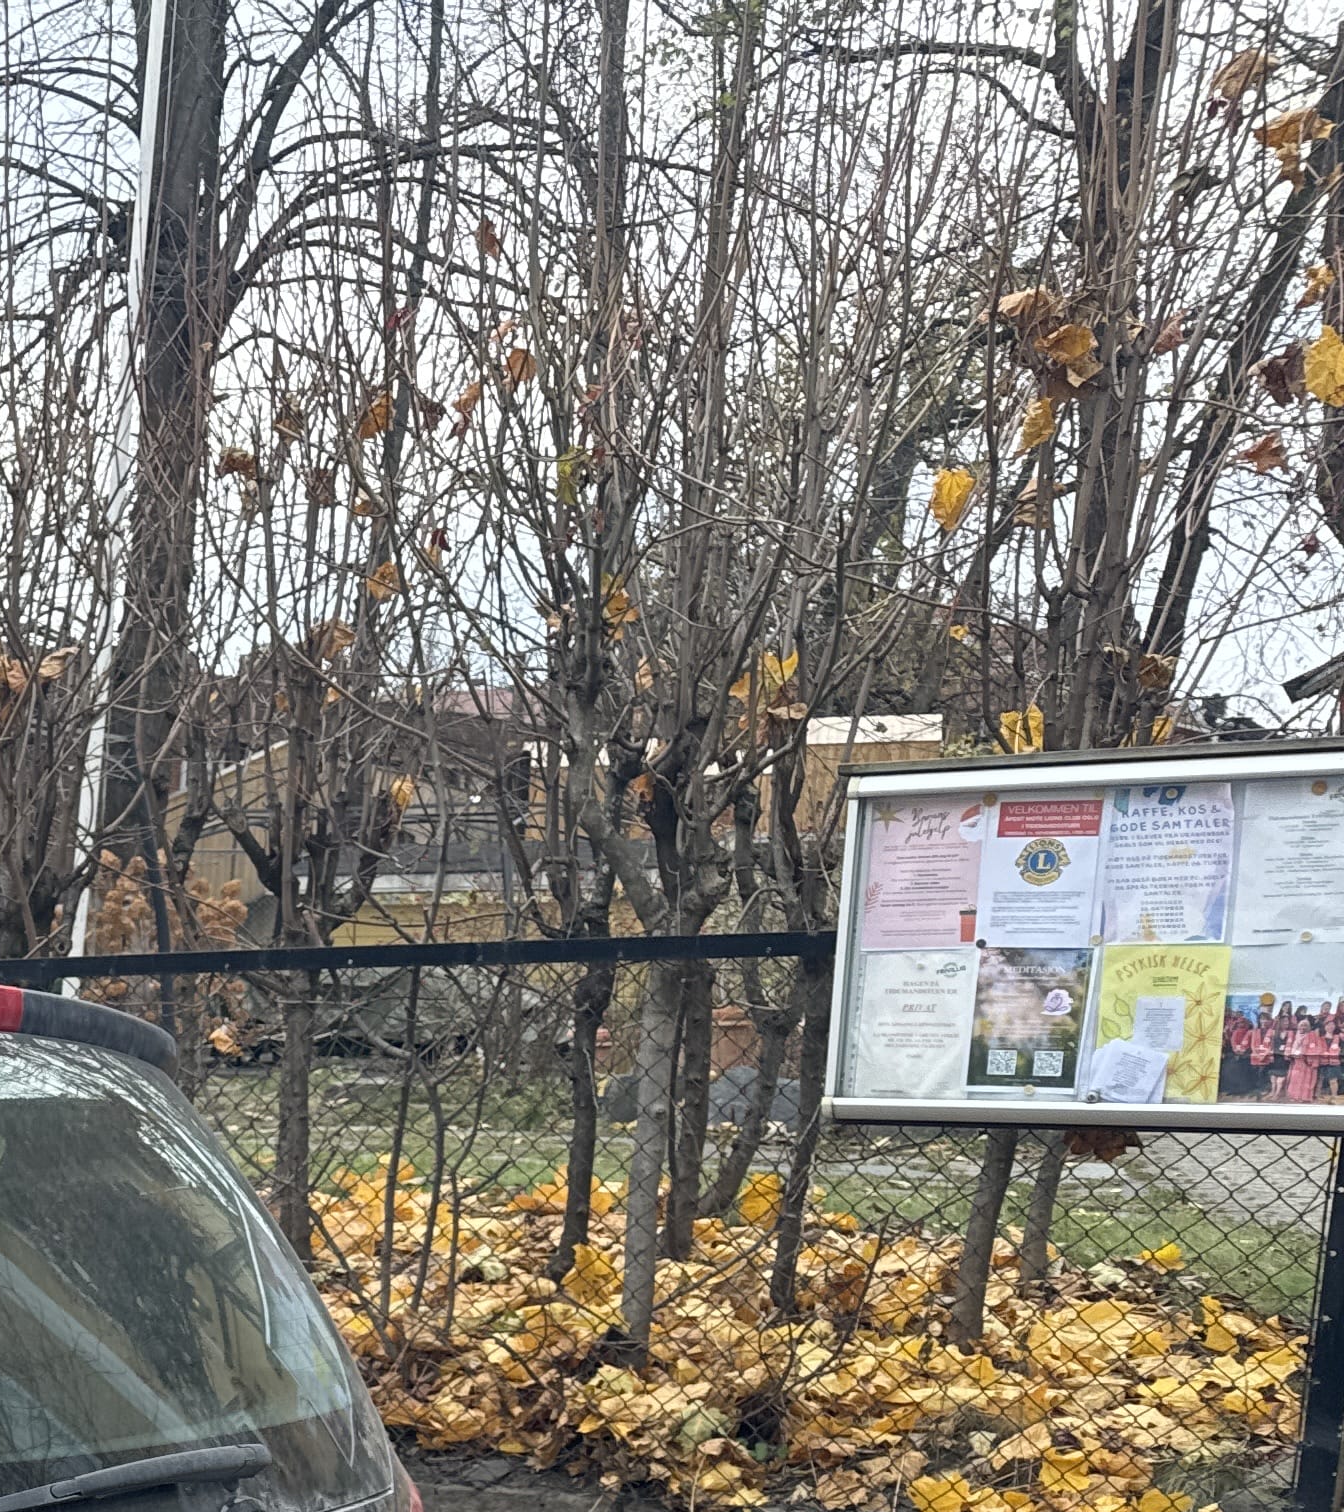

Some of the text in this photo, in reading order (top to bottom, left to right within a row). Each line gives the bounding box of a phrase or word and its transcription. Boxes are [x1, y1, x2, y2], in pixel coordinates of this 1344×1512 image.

[1008, 803, 1098, 814] VELKOMMEN TIL
[1178, 804, 1207, 815] KOS
[1110, 822, 1147, 833] GODE
[1152, 818, 1230, 831] SAMTALER
[1036, 852, 1051, 870] L
[1115, 954, 1168, 982] PSYKISK
[1171, 955, 1211, 978] HELSE
